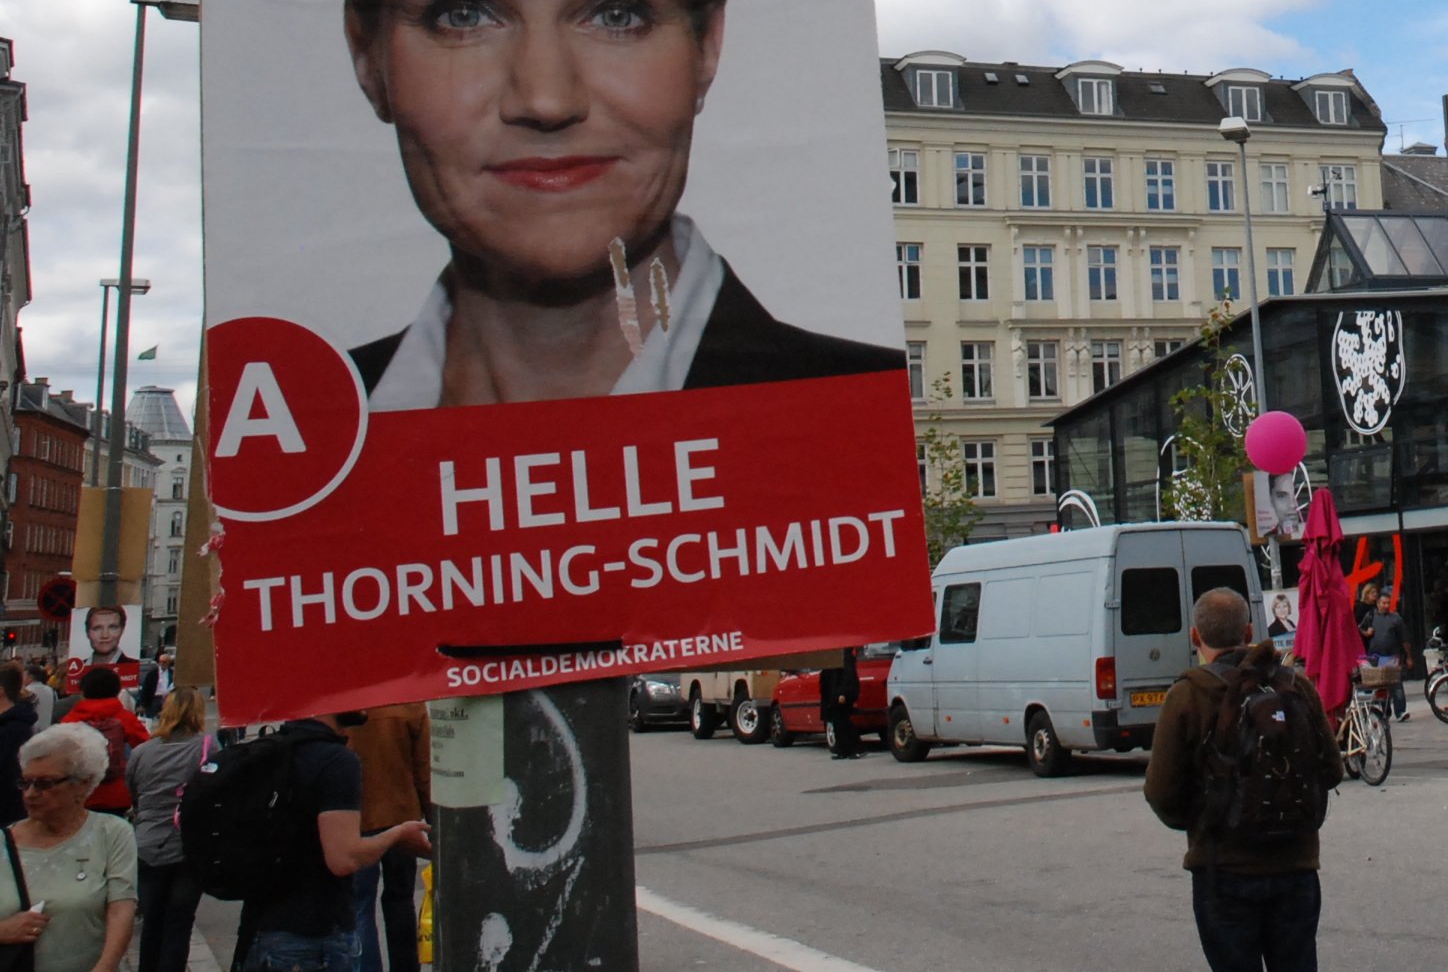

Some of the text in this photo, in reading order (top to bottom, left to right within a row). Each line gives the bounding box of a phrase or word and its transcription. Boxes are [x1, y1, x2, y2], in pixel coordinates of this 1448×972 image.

[213, 361, 307, 458] A
[437, 437, 726, 536] HELLE
[242, 508, 905, 633] THORNING-SCHMIDT
[446, 630, 744, 689] SOCIALDEMOKRATERNE
